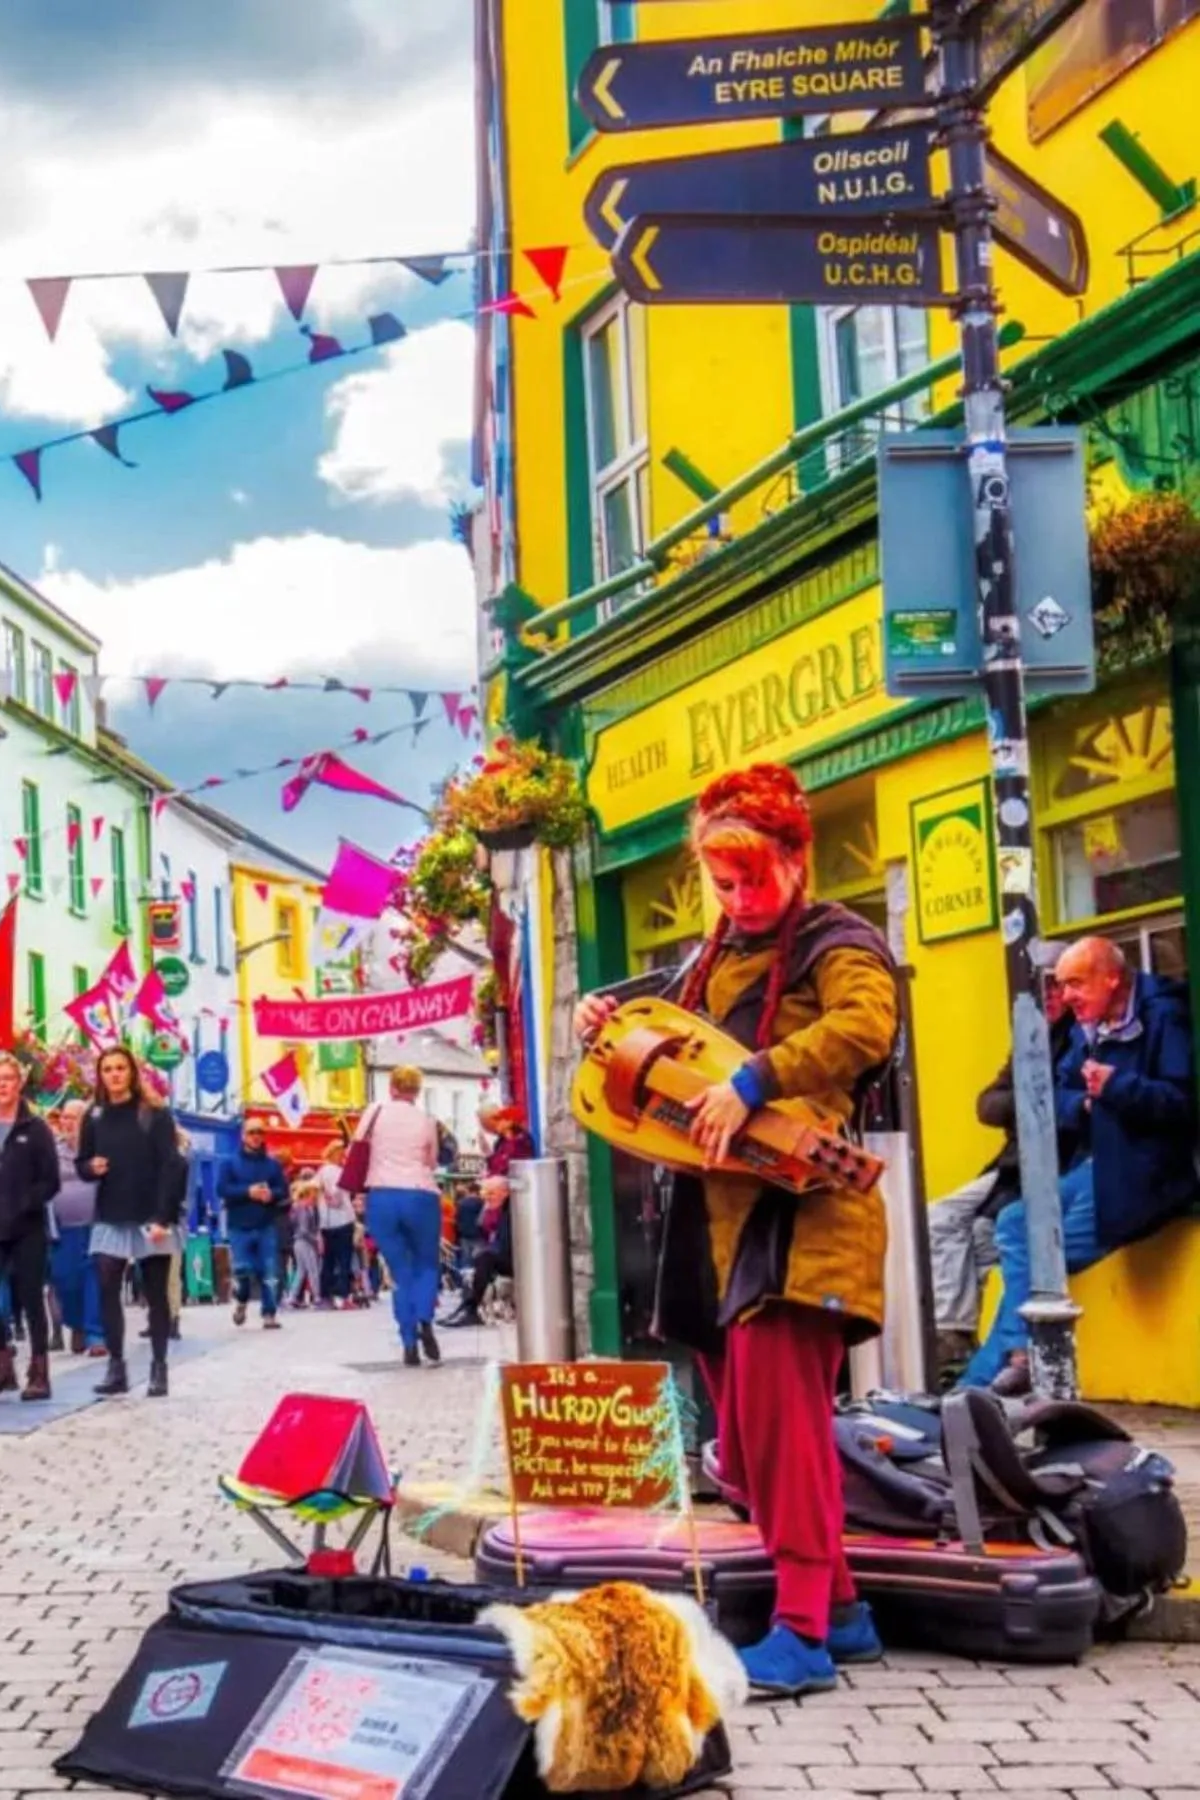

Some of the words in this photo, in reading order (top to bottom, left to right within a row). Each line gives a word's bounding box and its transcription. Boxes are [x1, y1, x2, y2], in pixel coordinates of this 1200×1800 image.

[688, 55, 723, 77] An
[730, 46, 828, 73] Fhaiche
[835, 36, 901, 63] Mhór
[715, 76, 786, 104] EYRE
[792, 66, 905, 97] SQUARE
[817, 171, 915, 204] N.U.I.G.
[824, 263, 922, 287] U.C.H.G.
[605, 739, 668, 791] HEALTH
[925, 886, 984, 916] CORNER
[326, 1006, 361, 1033] ON
[362, 989, 459, 1028] GALWAY
[536, 1434, 561, 1457] you
[562, 1433, 599, 1451] want
[604, 1436, 619, 1453] to
[571, 1454, 587, 1475] be
[530, 1477, 555, 1499] Ask
[557, 1481, 578, 1497] and
